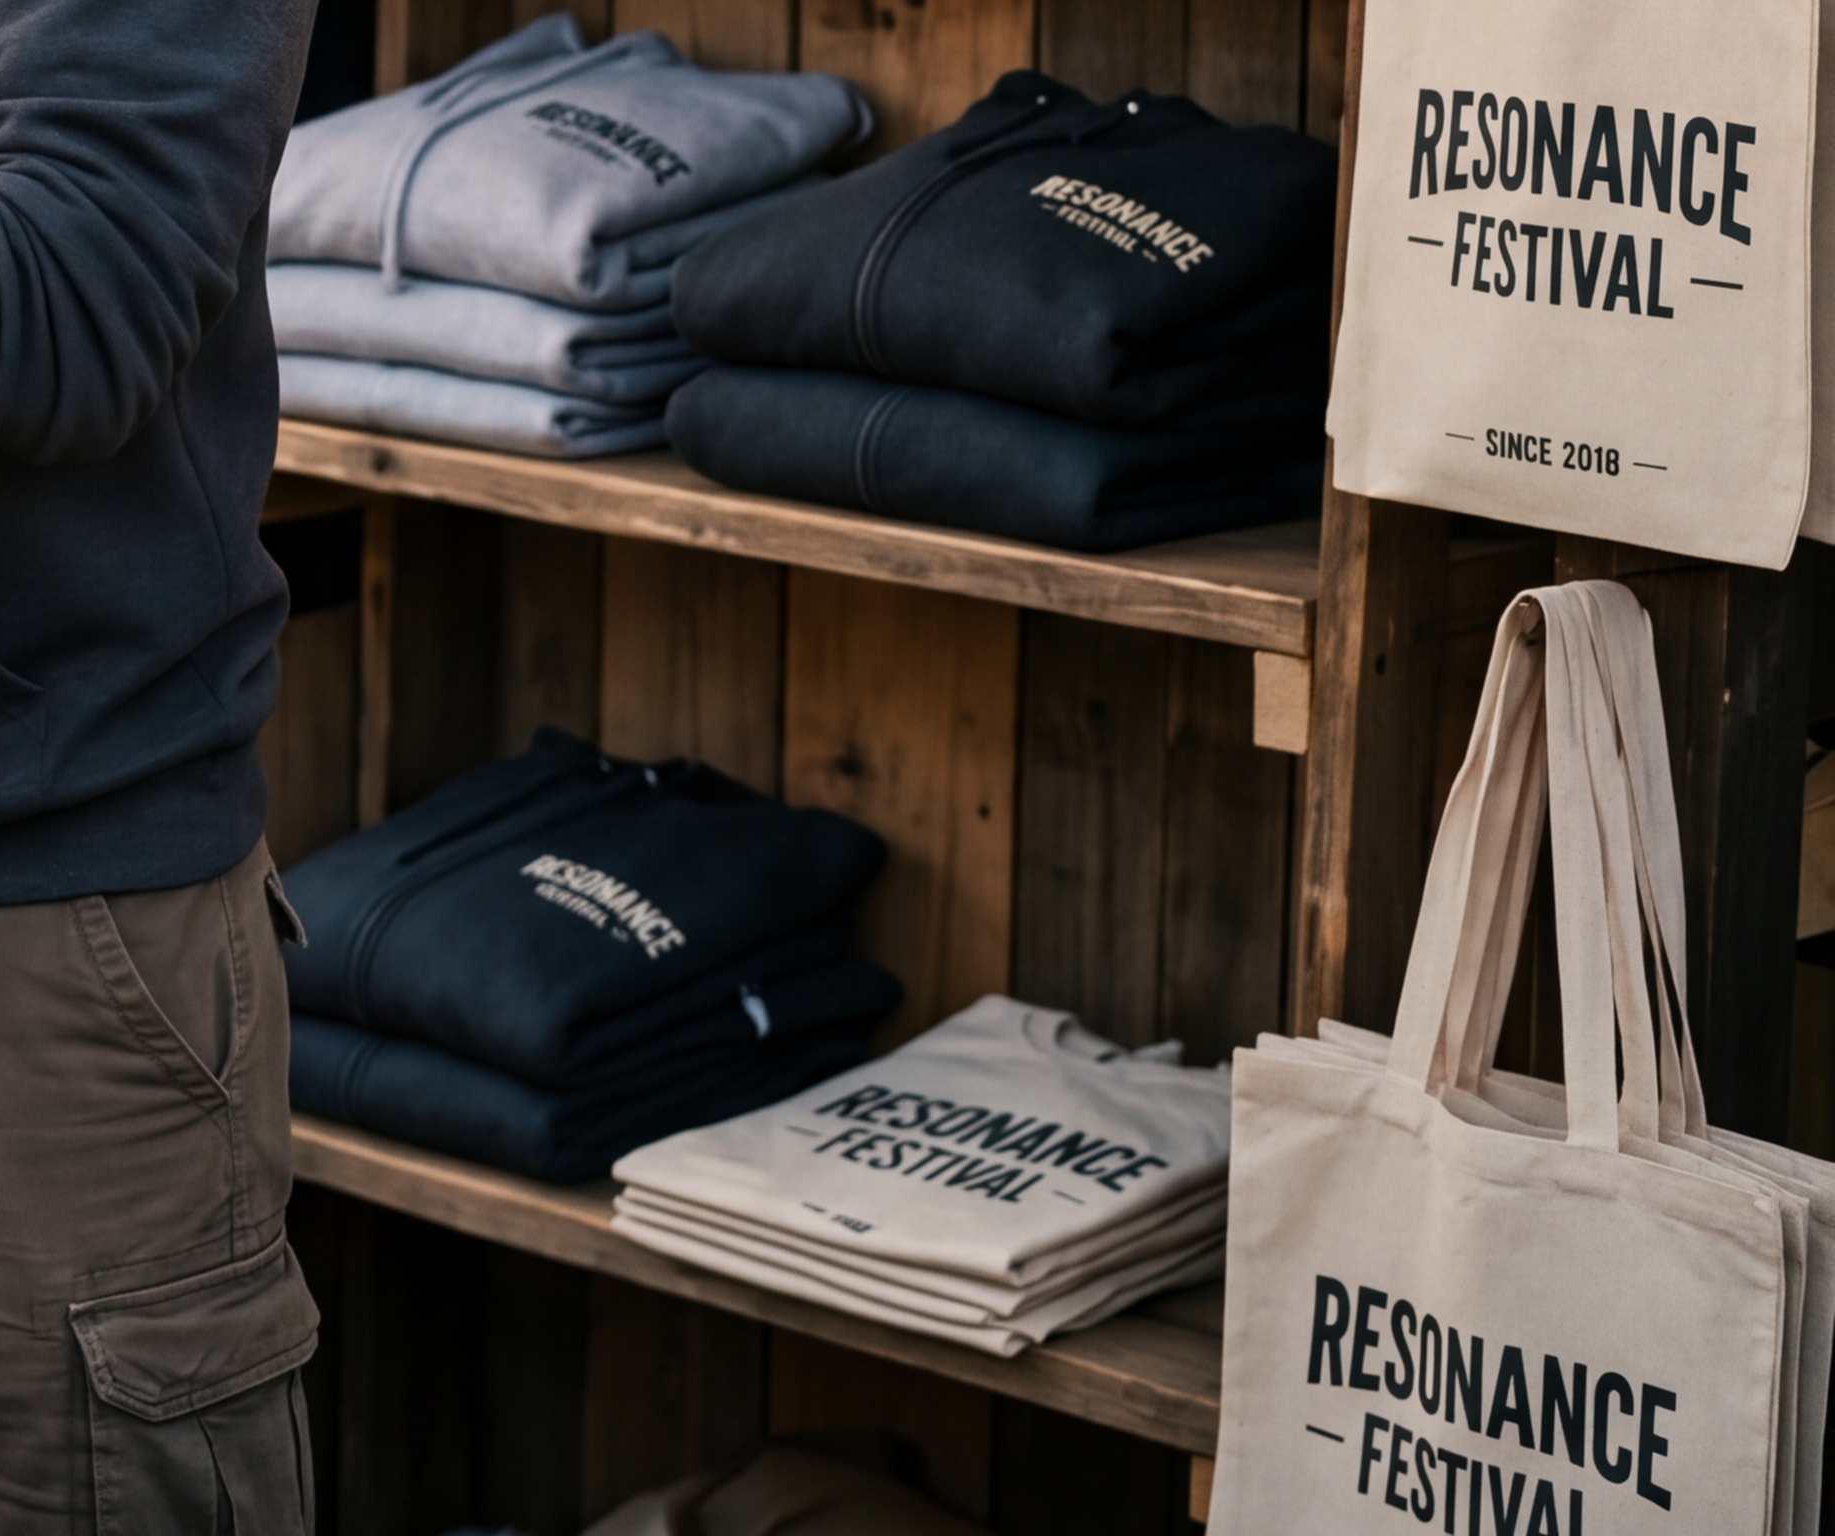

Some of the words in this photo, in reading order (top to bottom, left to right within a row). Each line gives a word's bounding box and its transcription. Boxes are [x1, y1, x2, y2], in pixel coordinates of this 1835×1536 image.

[1408, 88, 1757, 246] RESONANCE
[1030, 175, 1215, 273] RESONANCE
[1450, 211, 1675, 320] FESTIVAL
[1485, 428, 1552, 466] SINCE
[813, 1084, 1169, 1193] RESONANCE
[813, 1128, 1045, 1203] FESTIVAL
[1307, 1274, 1677, 1512] RESONANCE
